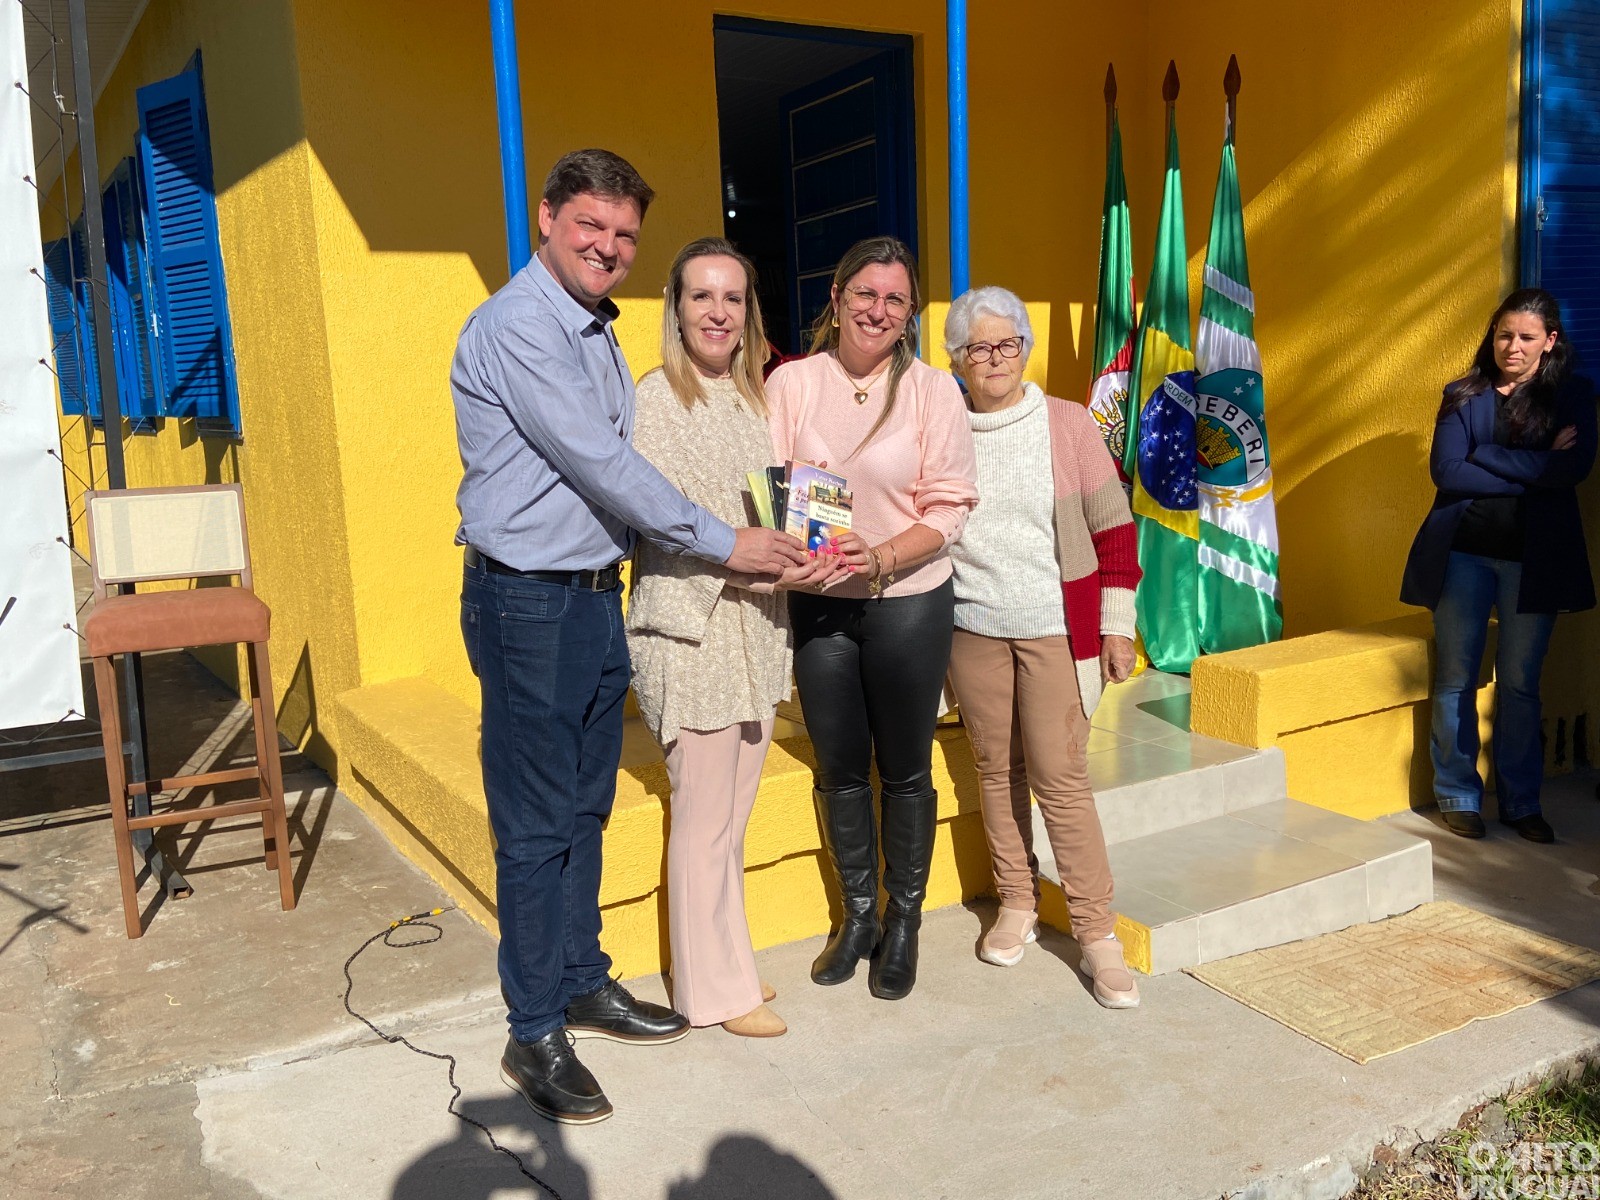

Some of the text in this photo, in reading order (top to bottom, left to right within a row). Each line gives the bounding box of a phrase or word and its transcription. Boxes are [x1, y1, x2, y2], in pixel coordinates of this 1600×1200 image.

[1163, 378, 1193, 407] ORDEM
[1195, 393, 1265, 464] SEBERI
[817, 505, 841, 517] Ninguém
